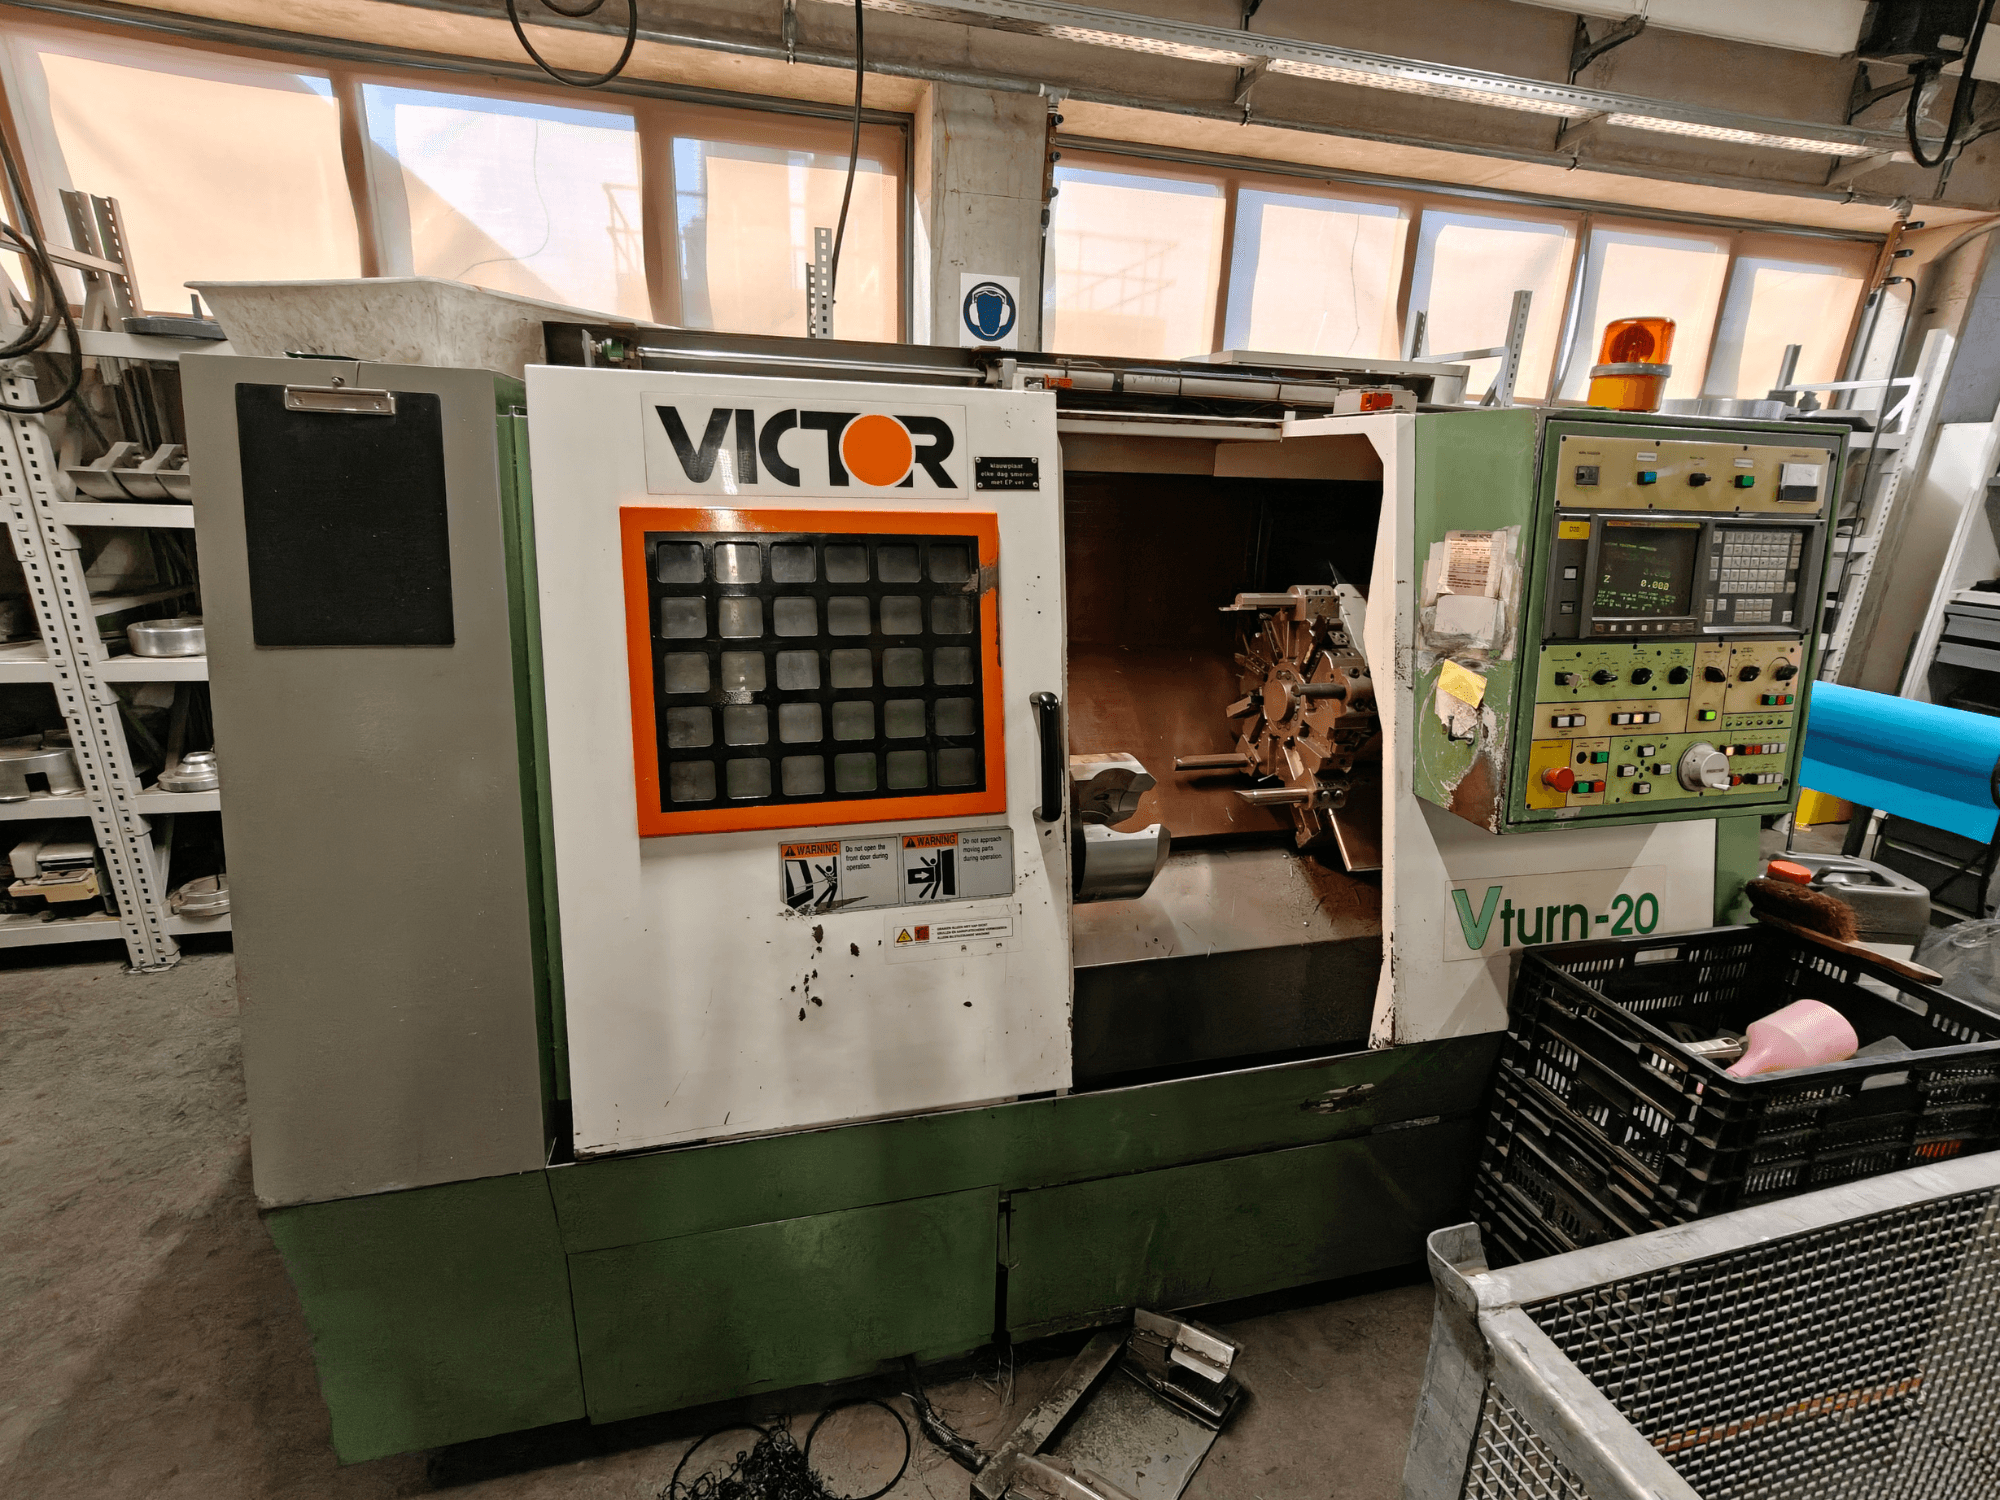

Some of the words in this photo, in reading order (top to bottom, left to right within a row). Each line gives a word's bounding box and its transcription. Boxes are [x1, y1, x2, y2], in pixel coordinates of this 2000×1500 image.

[655, 405, 958, 489] VICTOR
[1604, 575, 1611, 583] Z
[1640, 579, 1670, 591] 0.000
[917, 834, 956, 847] WARNING
[980, 836, 1002, 844] approach
[797, 843, 838, 856] WARNING
[864, 844, 876, 852] open
[1451, 886, 1659, 950] Vturn-20
